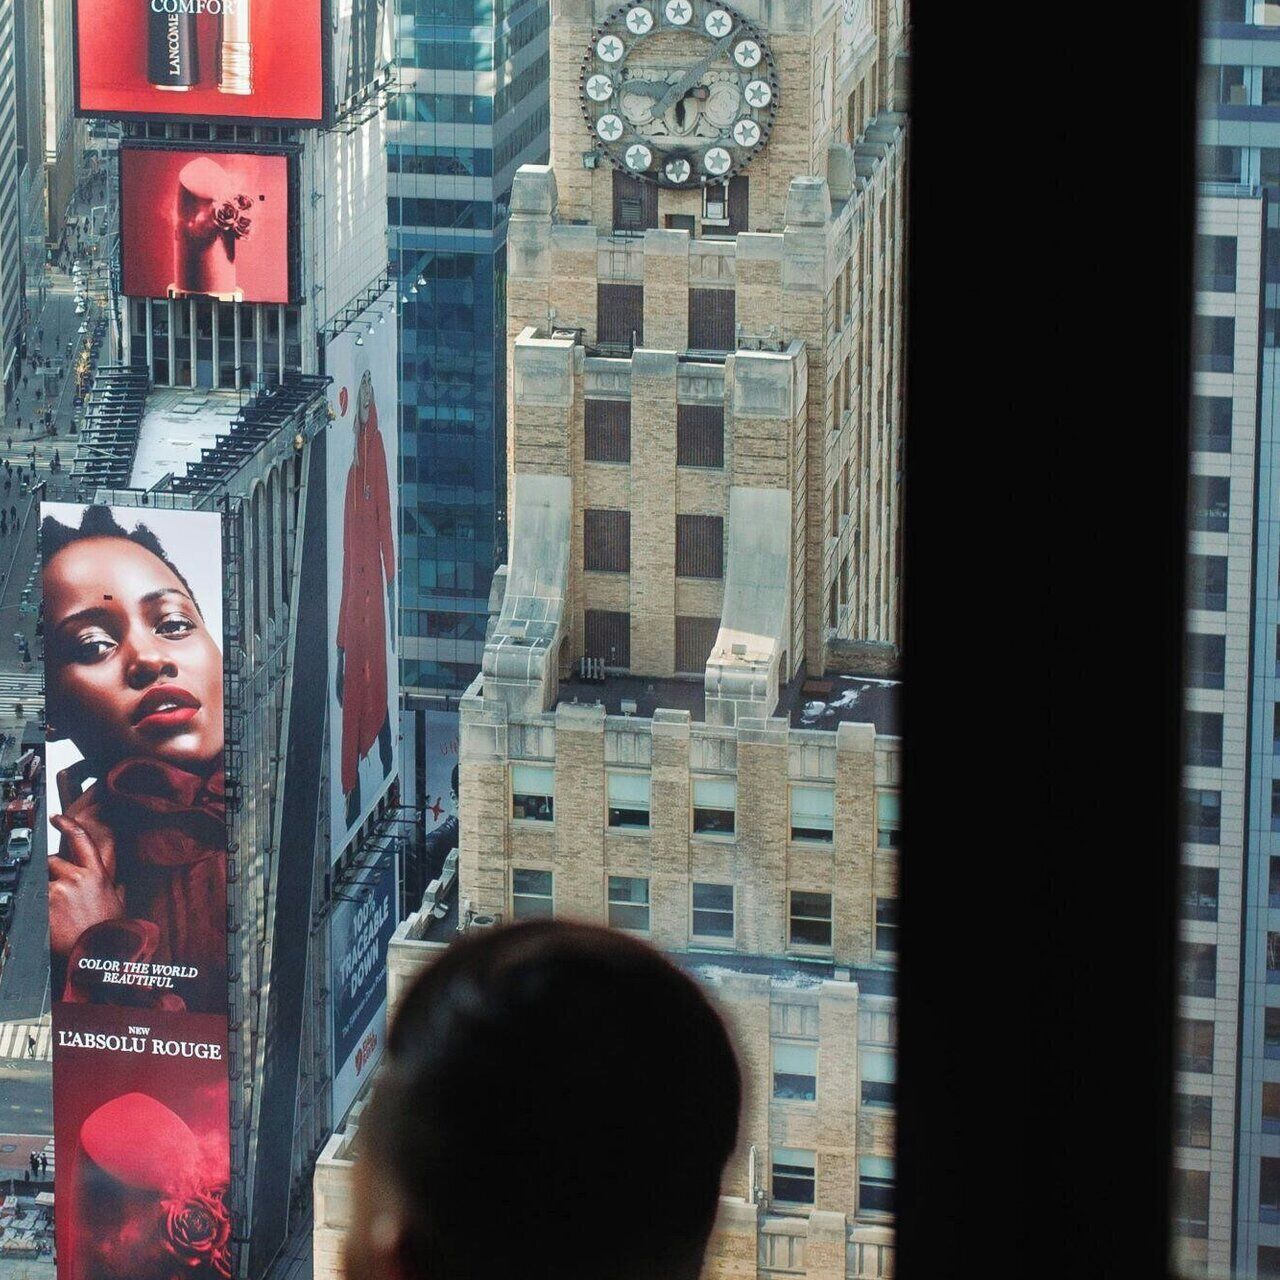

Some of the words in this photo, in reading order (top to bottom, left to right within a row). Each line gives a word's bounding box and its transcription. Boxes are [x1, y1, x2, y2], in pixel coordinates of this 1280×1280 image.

[339, 895, 389, 986] TRACEABLE
[78, 958, 120, 973] COLOR
[122, 961, 150, 975] THE
[151, 964, 199, 979] WORLD
[351, 937, 379, 998] DOWN
[102, 972, 174, 989] BEAUTIFUL
[128, 1026, 150, 1036] NEW
[58, 1030, 147, 1053] L'ABSOLU
[151, 1039, 222, 1060] ROUGE
